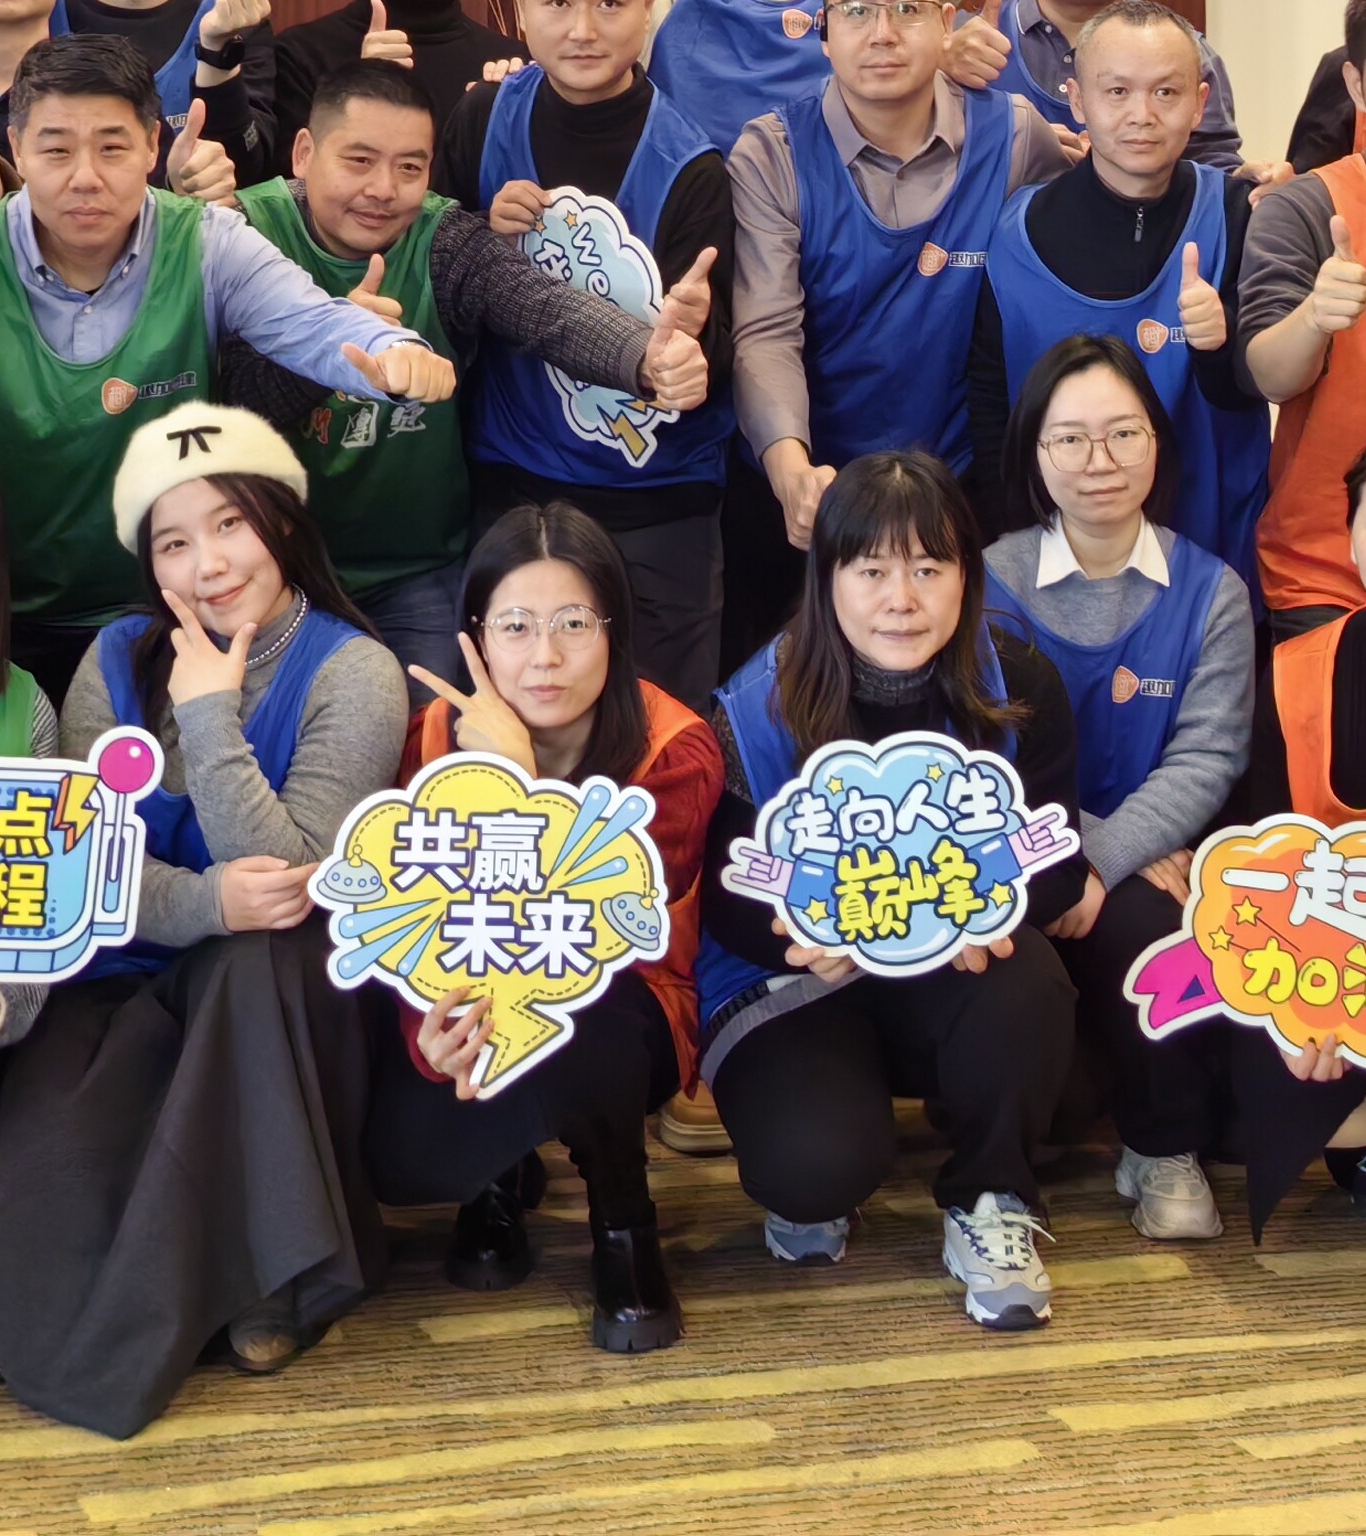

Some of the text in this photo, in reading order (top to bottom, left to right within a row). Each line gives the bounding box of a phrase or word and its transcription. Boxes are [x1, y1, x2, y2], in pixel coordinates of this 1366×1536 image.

[392, 810, 549, 892] 共赢
[787, 765, 1008, 857] 走向人生
[438, 892, 598, 975] 未来
[835, 838, 986, 942] 巅峰
